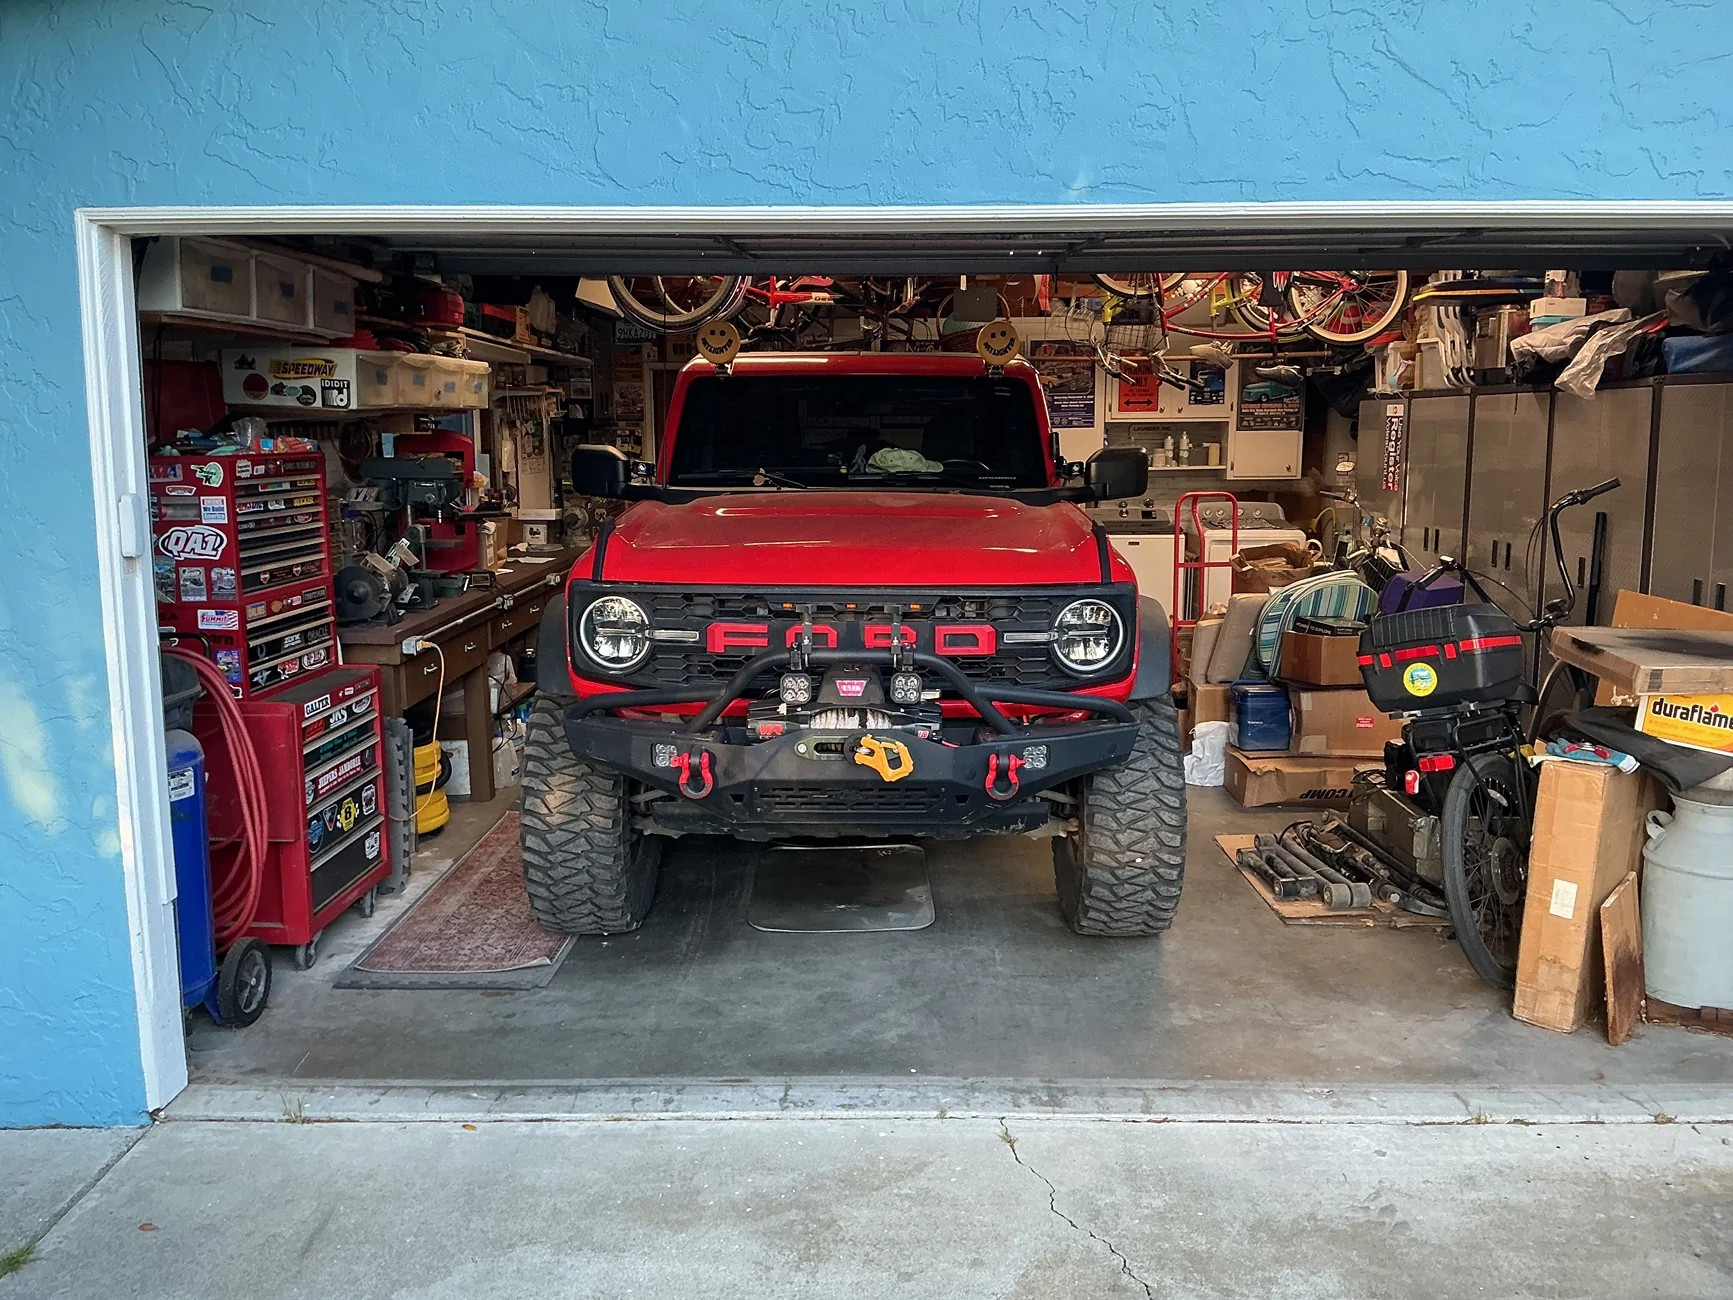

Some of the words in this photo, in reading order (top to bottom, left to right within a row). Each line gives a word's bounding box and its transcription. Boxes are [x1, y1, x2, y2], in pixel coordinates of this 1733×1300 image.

[281, 361, 335, 377] SPEEDWAY
[321, 379, 349, 388] IDIDIT
[1387, 418, 1399, 490] Register
[204, 475, 213, 485] K
[167, 530, 217, 557] QA1
[201, 613, 228, 623] SUMMIT
[307, 625, 329, 640] ORACLE
[706, 622, 997, 657] FORD
[306, 696, 330, 715] GALFER
[330, 708, 348, 724] JKS
[760, 723, 783, 736] VR
[318, 768, 338, 790] JEEPERS
[338, 755, 362, 777] JAMBOREE
[1299, 788, 1348, 800] COMP
[344, 806, 352, 821] 8
